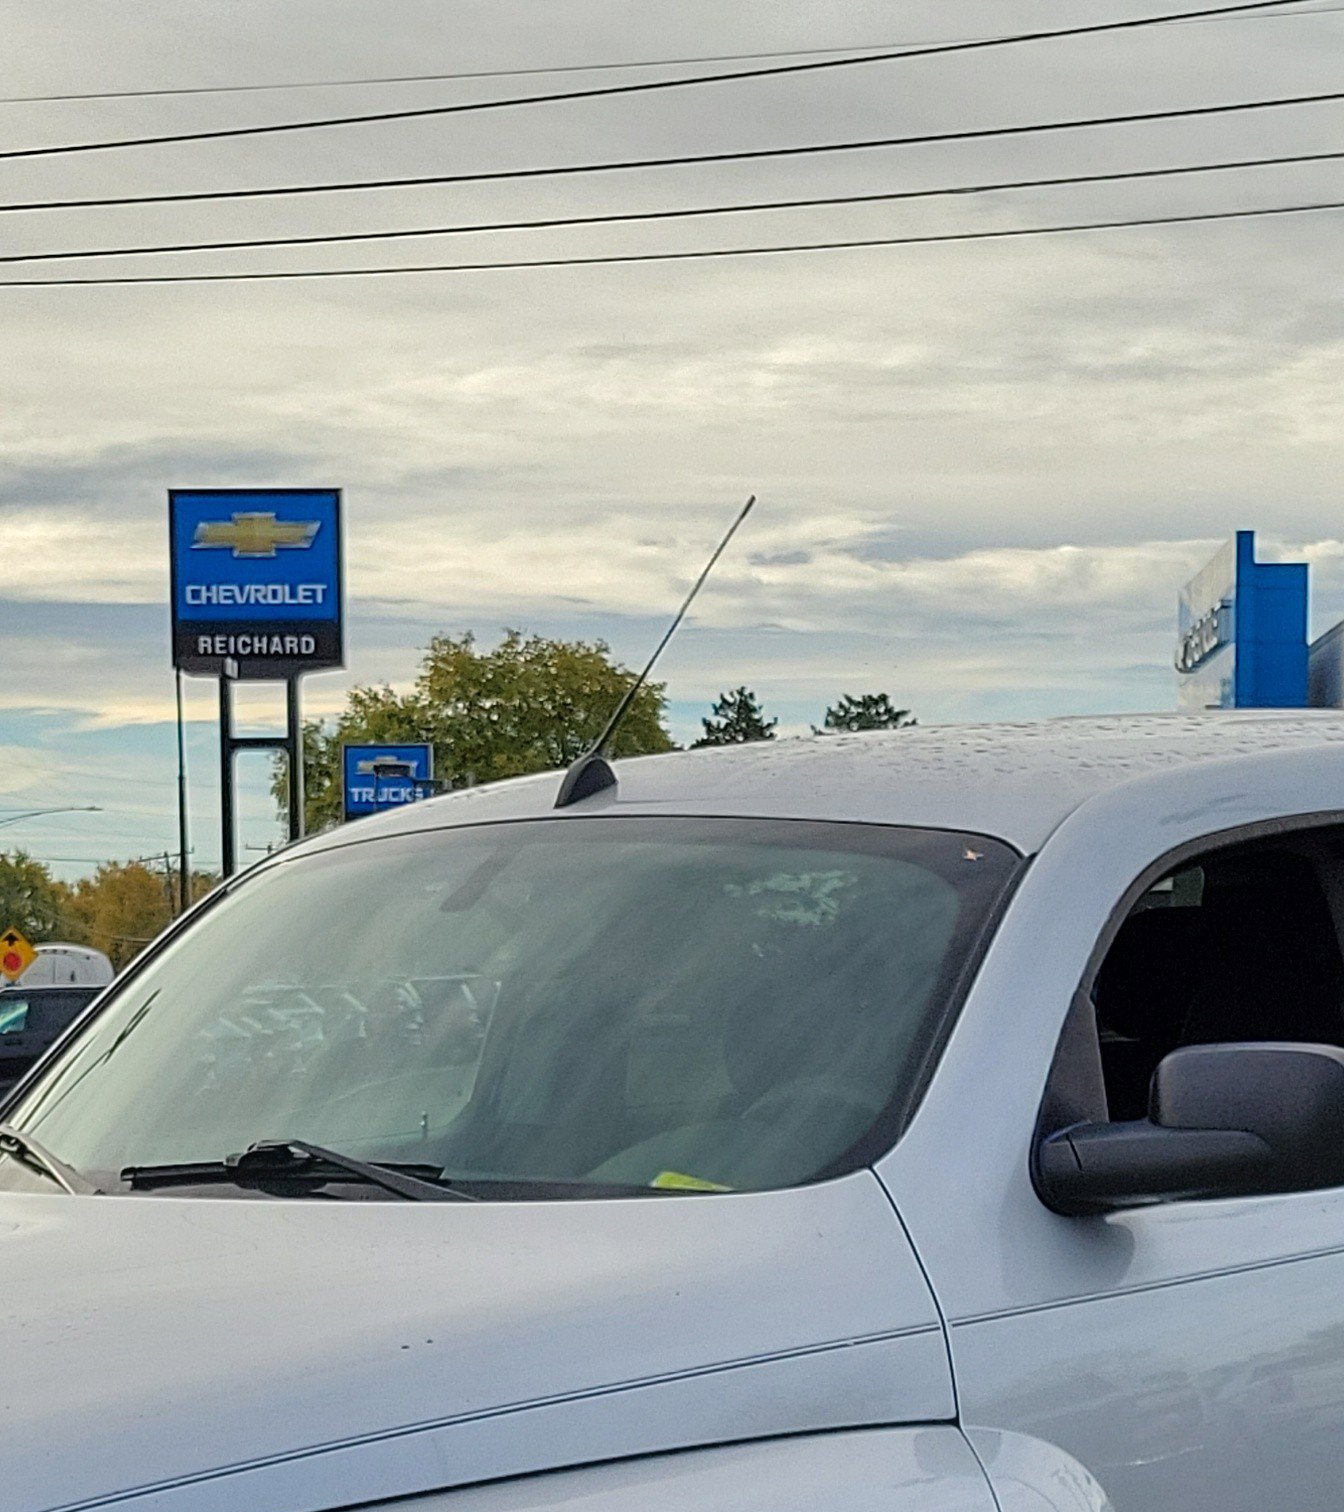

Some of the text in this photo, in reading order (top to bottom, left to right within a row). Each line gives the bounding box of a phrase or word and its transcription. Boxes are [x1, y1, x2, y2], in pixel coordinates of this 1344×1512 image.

[185, 584, 327, 605] CHEVROLET
[198, 635, 316, 656] REICHARD
[349, 786, 424, 803] TRUCKS
